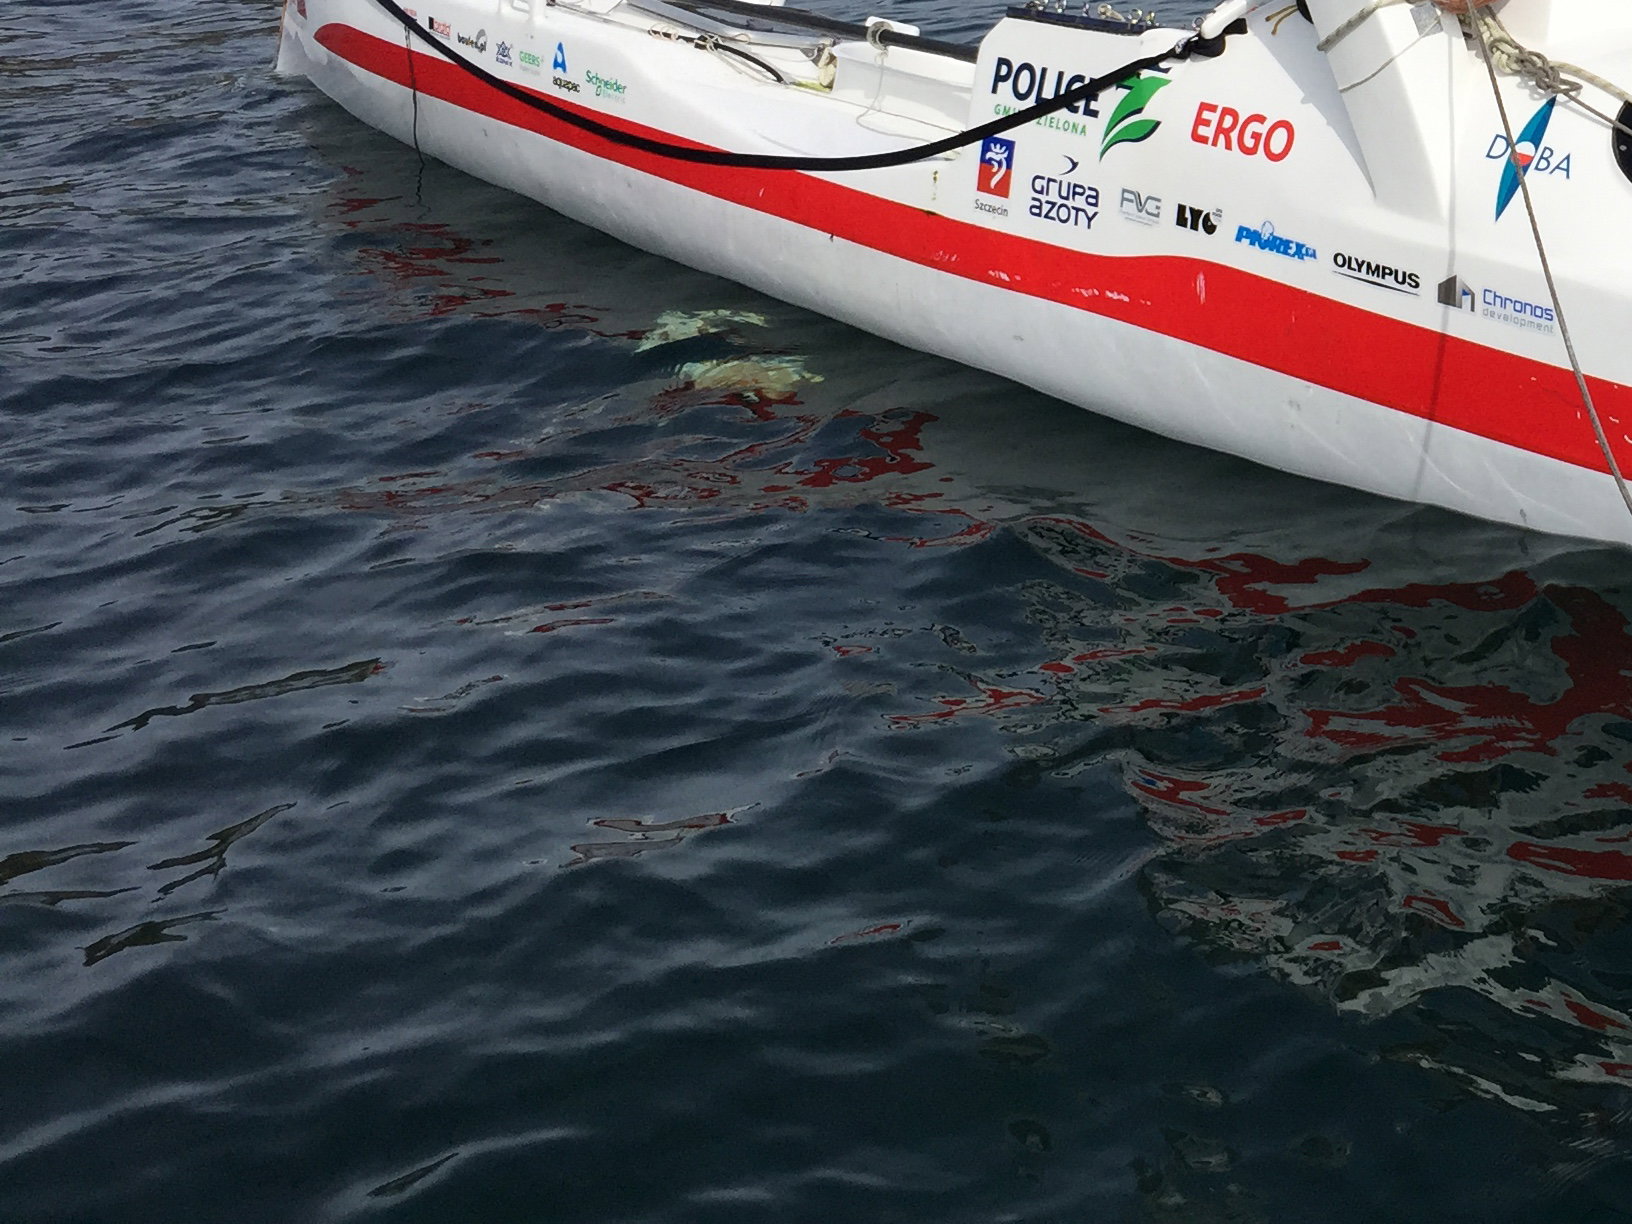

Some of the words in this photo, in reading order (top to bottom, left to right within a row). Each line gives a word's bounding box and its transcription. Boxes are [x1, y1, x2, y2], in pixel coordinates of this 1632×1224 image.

[1191, 101, 1295, 162] ERGO
[974, 198, 1009, 217] Szczecin
[1333, 252, 1421, 289] OLYMPUS
[1482, 308, 1554, 333] development
[1483, 288, 1554, 322] Chronos
